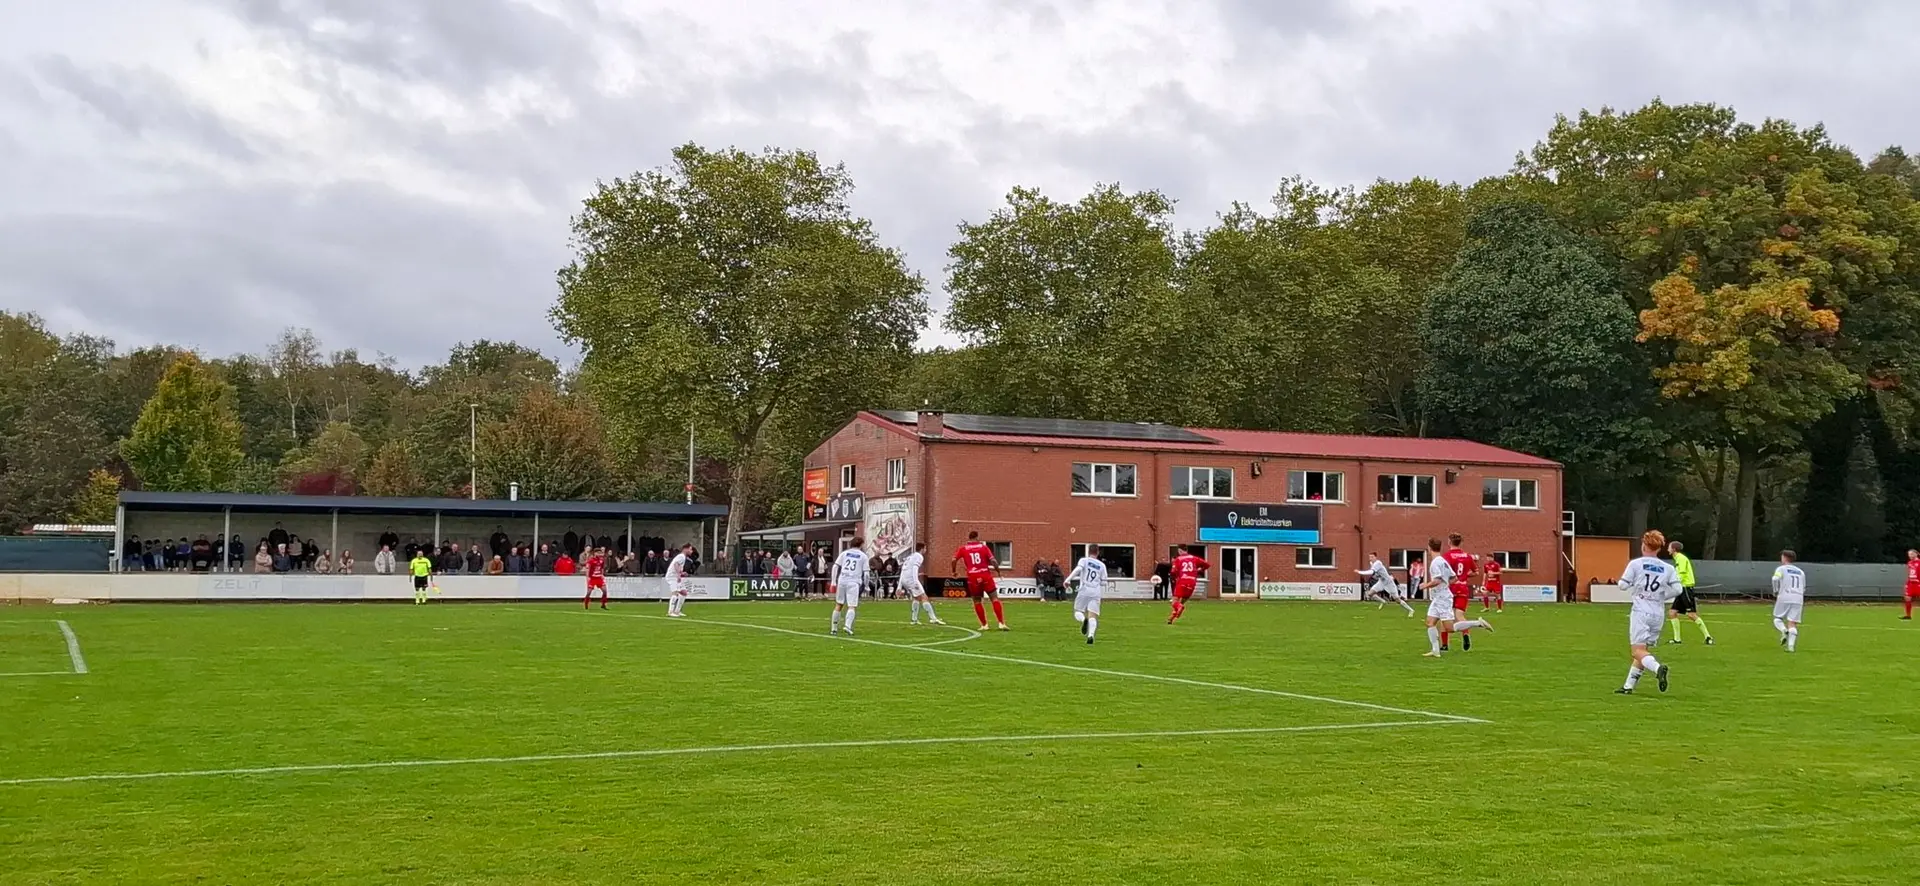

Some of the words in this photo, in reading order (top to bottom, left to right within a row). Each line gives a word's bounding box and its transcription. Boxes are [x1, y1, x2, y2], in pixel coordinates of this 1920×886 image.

[844, 559, 857, 571] 23
[968, 552, 982, 565] 18
[1182, 562, 1194, 572] 23
[1457, 562, 1464, 575] 8
[1086, 568, 1097, 583] 19
[1791, 575, 1800, 588] 11
[751, 579, 790, 590] RAMO
[1644, 573, 1660, 592] 16
